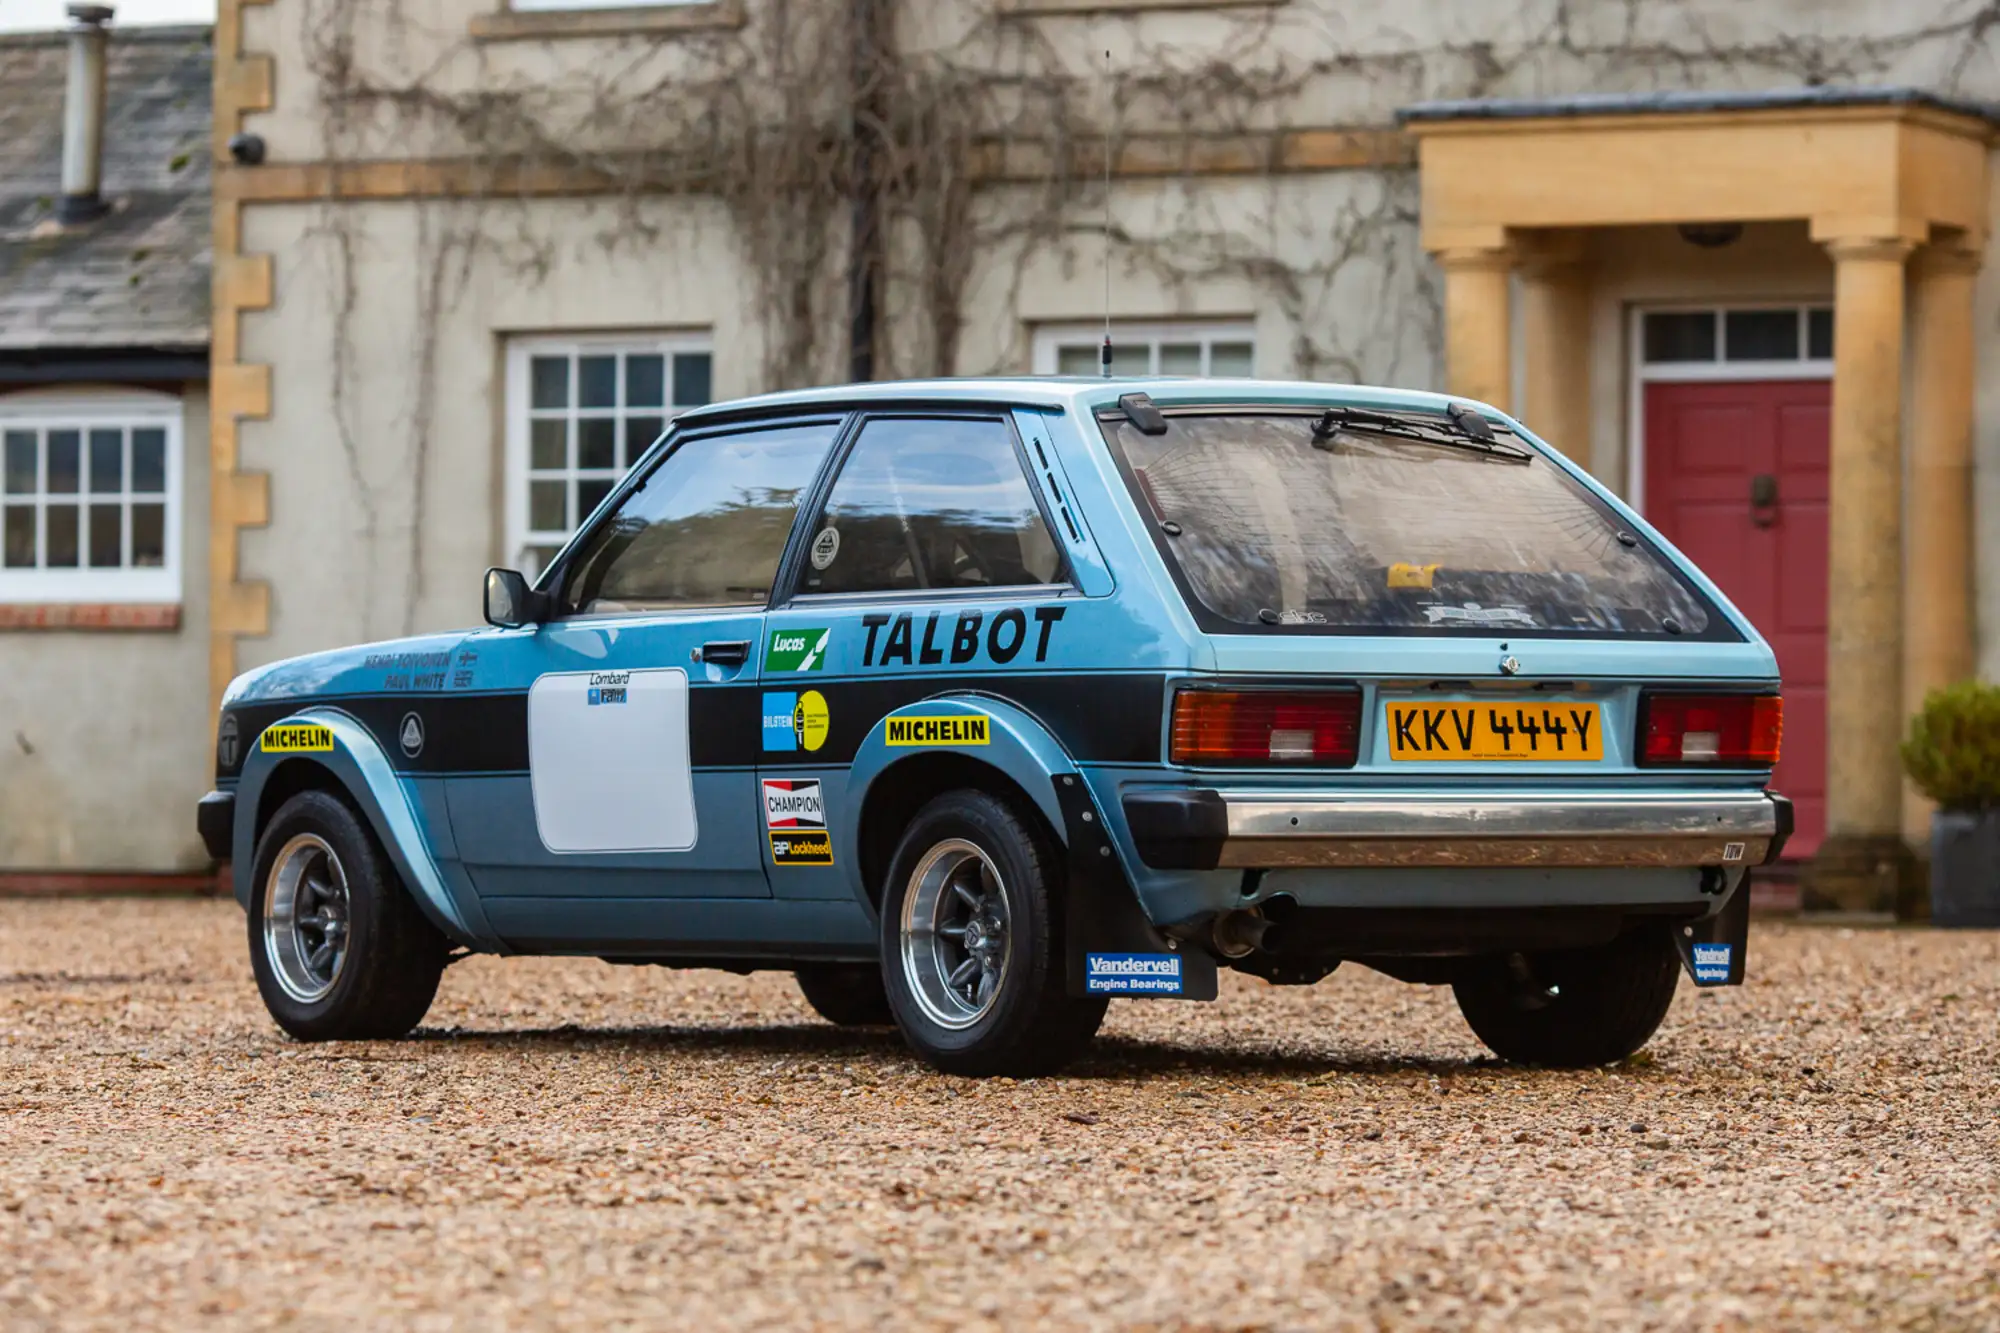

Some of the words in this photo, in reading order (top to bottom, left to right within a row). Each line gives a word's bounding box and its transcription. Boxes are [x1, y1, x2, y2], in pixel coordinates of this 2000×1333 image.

[773, 633, 806, 652] Lucas
[862, 607, 1067, 666] TALBOT
[384, 674, 410, 689] PAUL
[413, 671, 446, 689] WHITE
[590, 671, 631, 686] Lombard
[763, 715, 793, 728] BILSTEIN
[890, 720, 985, 741] MICHELIN
[1394, 709, 1475, 751] KKV
[1489, 709, 1593, 751] 444Y
[264, 729, 331, 748] MICHELIN
[768, 796, 822, 813] CHAMPION
[1090, 957, 1179, 975] Vandervell
[1090, 978, 1128, 991] Engine
[1130, 978, 1180, 992] Bearings
